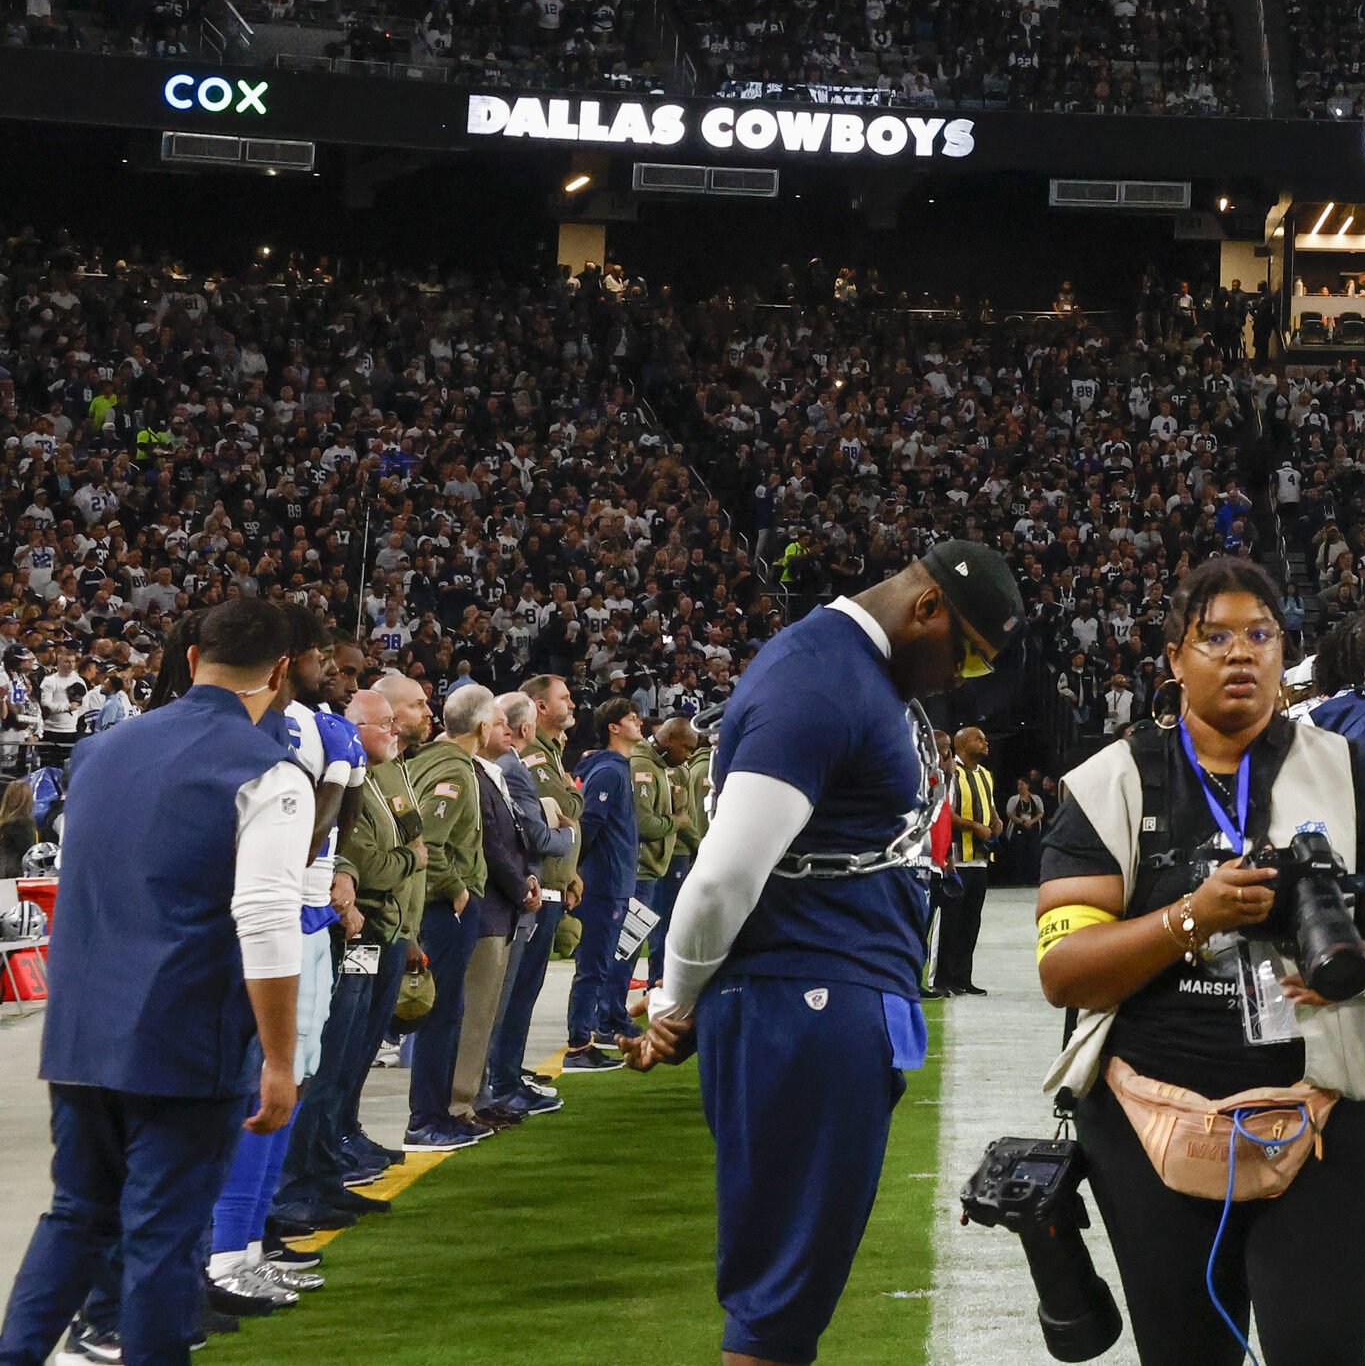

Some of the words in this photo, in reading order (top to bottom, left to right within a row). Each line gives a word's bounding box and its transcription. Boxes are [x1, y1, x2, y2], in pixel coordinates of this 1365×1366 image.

[162, 73, 269, 115] COX
[466, 92, 686, 146] DALLAS
[700, 106, 975, 158] COWBOYS
[1163, 422, 1170, 433] 4
[1288, 474, 1295, 486] 4
[526, 608, 535, 624] 8
